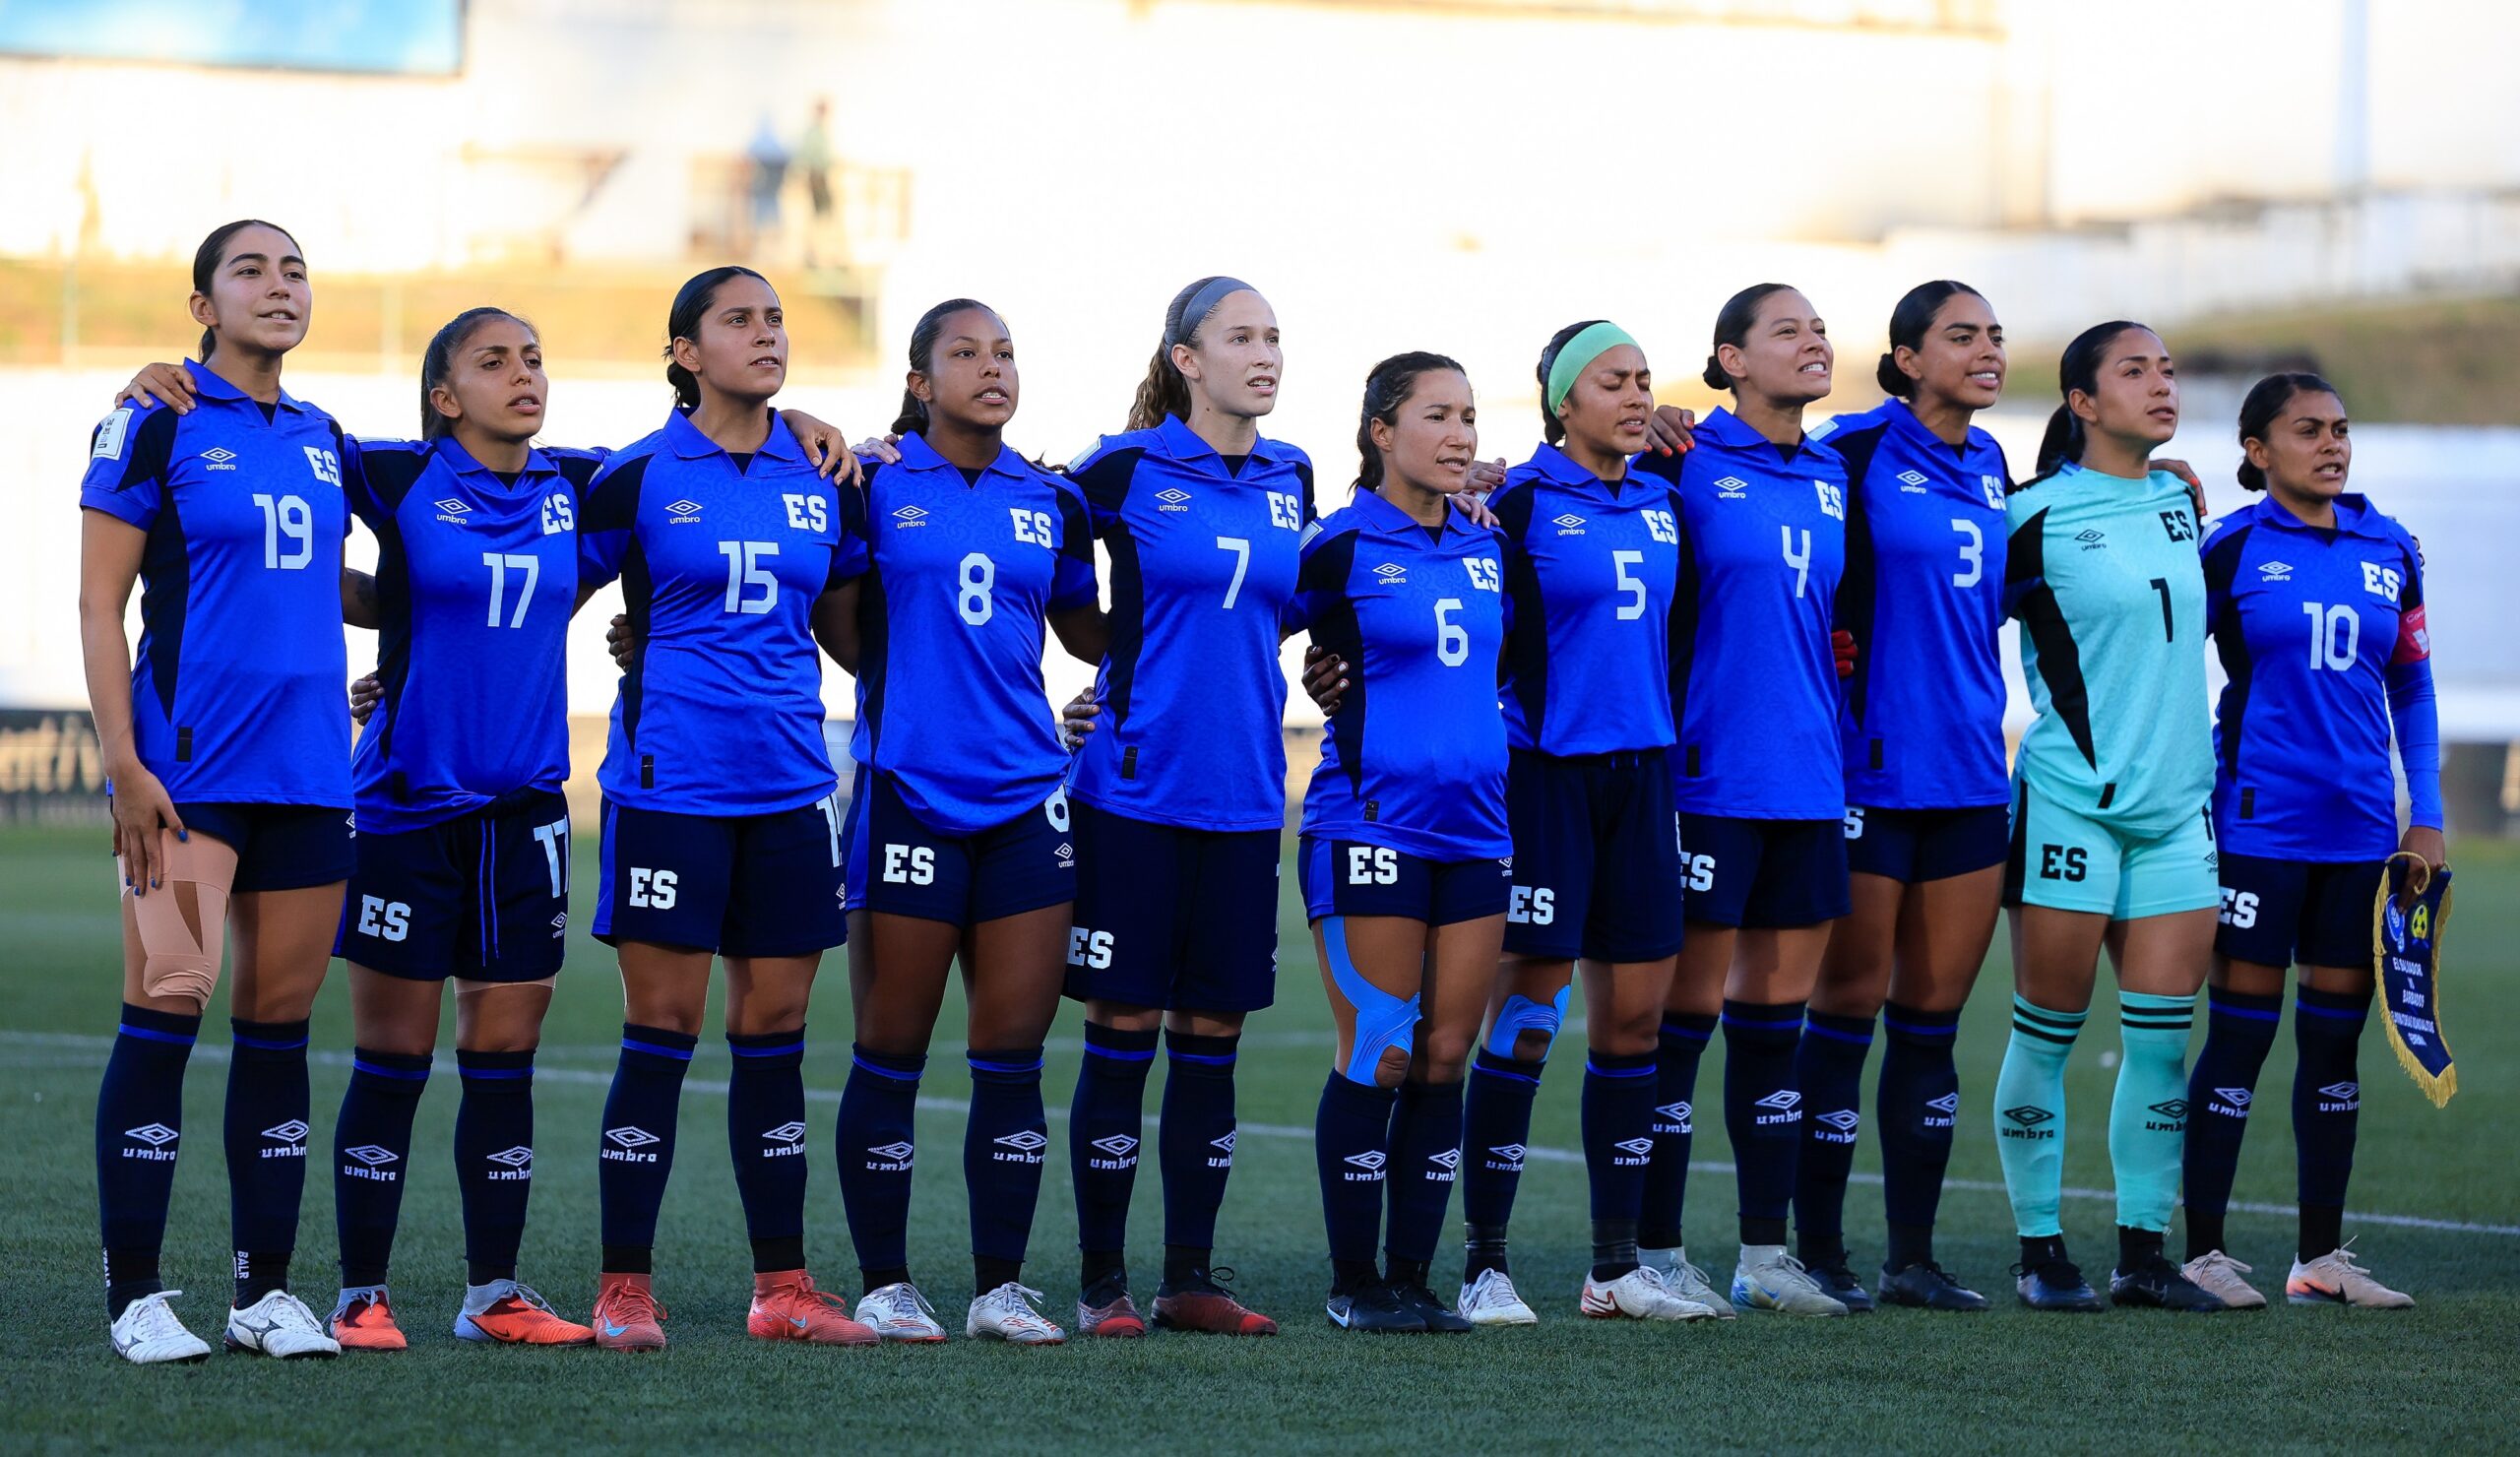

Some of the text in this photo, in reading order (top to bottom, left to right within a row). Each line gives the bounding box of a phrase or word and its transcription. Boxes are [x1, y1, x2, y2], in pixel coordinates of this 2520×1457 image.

[206, 463, 236, 472] umbro
[303, 446, 342, 487] ES
[1814, 479, 1844, 522] ES
[1900, 485, 1926, 494] umbro
[1982, 475, 2007, 511] ES
[252, 493, 313, 570] 19
[436, 514, 468, 525] umbro
[541, 493, 574, 536] ES
[669, 515, 701, 525] umbro
[782, 493, 827, 534] ES
[897, 519, 926, 529] umbro
[1009, 508, 1052, 549] ES
[1266, 490, 1300, 533] ES
[1640, 509, 1678, 544] ES
[2159, 510, 2194, 542] ES
[1781, 525, 1811, 599] 4
[1951, 518, 1984, 588] 3
[2081, 541, 2107, 551] umbro
[482, 551, 539, 629] 17
[718, 540, 780, 614] 15
[959, 552, 995, 626] 8
[1216, 536, 1251, 609] 7
[1379, 576, 1407, 585] umbro
[1462, 557, 1500, 594] ES
[1612, 550, 1647, 620] 5
[2262, 573, 2291, 582] umbro
[2361, 560, 2400, 603] ES
[2150, 577, 2174, 644] 1
[1433, 598, 1469, 667] 6
[2302, 602, 2360, 671] 10
[883, 843, 934, 885] ES
[1348, 847, 1398, 885] ES
[2040, 844, 2087, 883] ES
[629, 866, 678, 910] ES
[1507, 885, 1555, 925] ES
[358, 893, 411, 942] ES
[1067, 926, 1114, 970] ES
[123, 1146, 176, 1162] umbro
[2002, 1127, 2053, 1140] umbro
[345, 1165, 397, 1181] umbro
[601, 1149, 658, 1163] umbro
[1090, 1155, 1137, 1171] umbro
